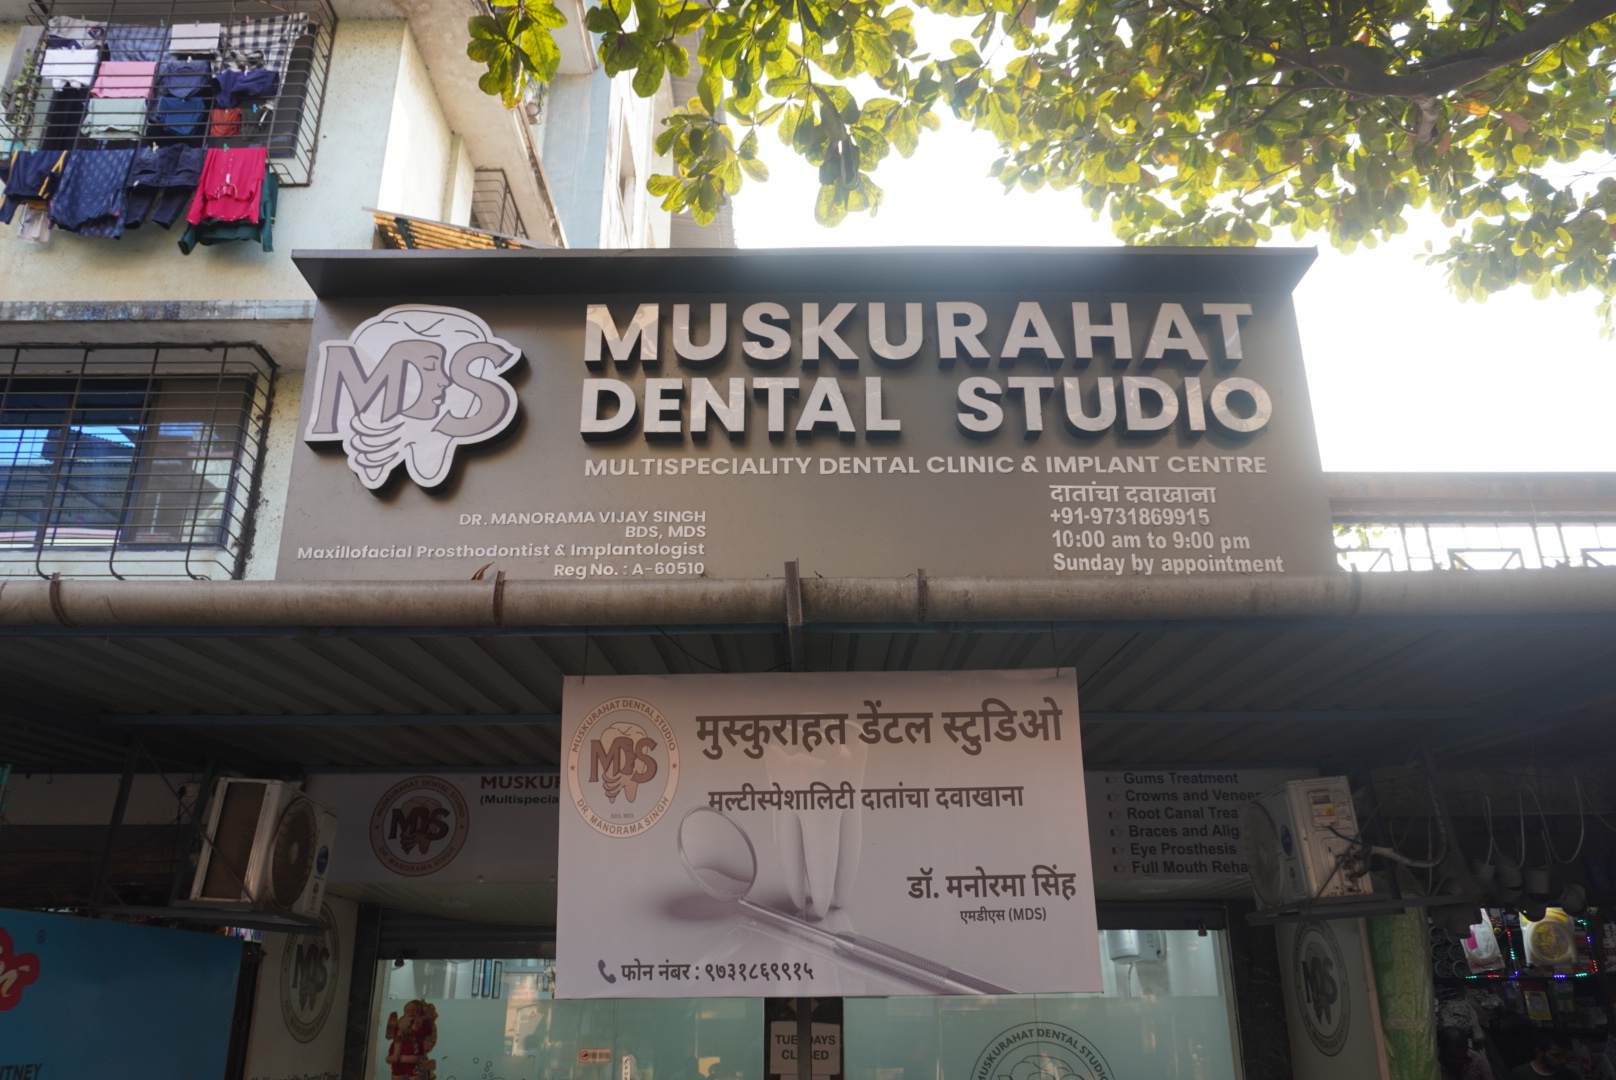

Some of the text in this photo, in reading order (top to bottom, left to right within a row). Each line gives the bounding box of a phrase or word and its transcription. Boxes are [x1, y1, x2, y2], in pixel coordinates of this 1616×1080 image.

[584, 301, 1253, 364] MUSKURAHAT
[311, 339, 515, 438] MDS
[580, 375, 1273, 435] DENTAL STUDIO
[584, 455, 1268, 477] MULTISPECIALITY DENTAL CLINIC & IMPLANT CENTRE
[1049, 481, 1217, 504] दातांचा दवाखाना
[459, 510, 706, 526] DR. MANORAMA VIJAY SINGH
[1050, 507, 1211, 526] +91-9731869915
[625, 525, 707, 540] BDS, MDS
[1052, 529, 1251, 554] 10:00 am to 9:00 pm
[297, 541, 705, 560] Maxillofacial Prosthodontist & Implantologist
[554, 563, 587, 580] Reg
[590, 563, 619, 576] No.
[632, 562, 705, 576] A-60510
[1052, 553, 1285, 576] Sunday by appointment
[572, 699, 676, 753] MUSKURAHAT DENTAL STUDIO
[696, 696, 1064, 760] मुस्कुराहत डेंटल स्टुडिओ
[588, 736, 658, 784] MDS
[1123, 772, 1239, 784] Gums Treatment
[376, 780, 419, 817] MUSKURAHAT
[422, 779, 449, 793] DENTAL
[708, 780, 1025, 811] मल्टीस्पेशालिटी दातांचा दवाखाना
[1125, 789, 1179, 801] Crowns
[1183, 789, 1209, 801] and
[388, 807, 451, 842] MDS
[576, 796, 670, 836] DR. MANORAMA SINGH
[1127, 807, 1161, 820] Root
[1164, 807, 1205, 819] Canal
[1129, 825, 1178, 837] Braces
[1182, 825, 1208, 837] and
[1130, 842, 1237, 858] Eye Prosthesis
[388, 857, 433, 873] MANORAMA
[1132, 861, 1159, 873] Full
[1163, 861, 1208, 873] Mouth
[906, 864, 1077, 901] डॉ. मनोरमा सिंह
[959, 906, 1047, 924] एमडीएस (MDS)
[620, 958, 654, 981] फोन
[658, 959, 691, 981] नंबर
[704, 962, 815, 982] ९७३१८६९९१५
[775, 1034, 836, 1045] TUEAYS
[1037, 1028, 1079, 1050] DENTAL
[781, 1050, 829, 1060] CLED
